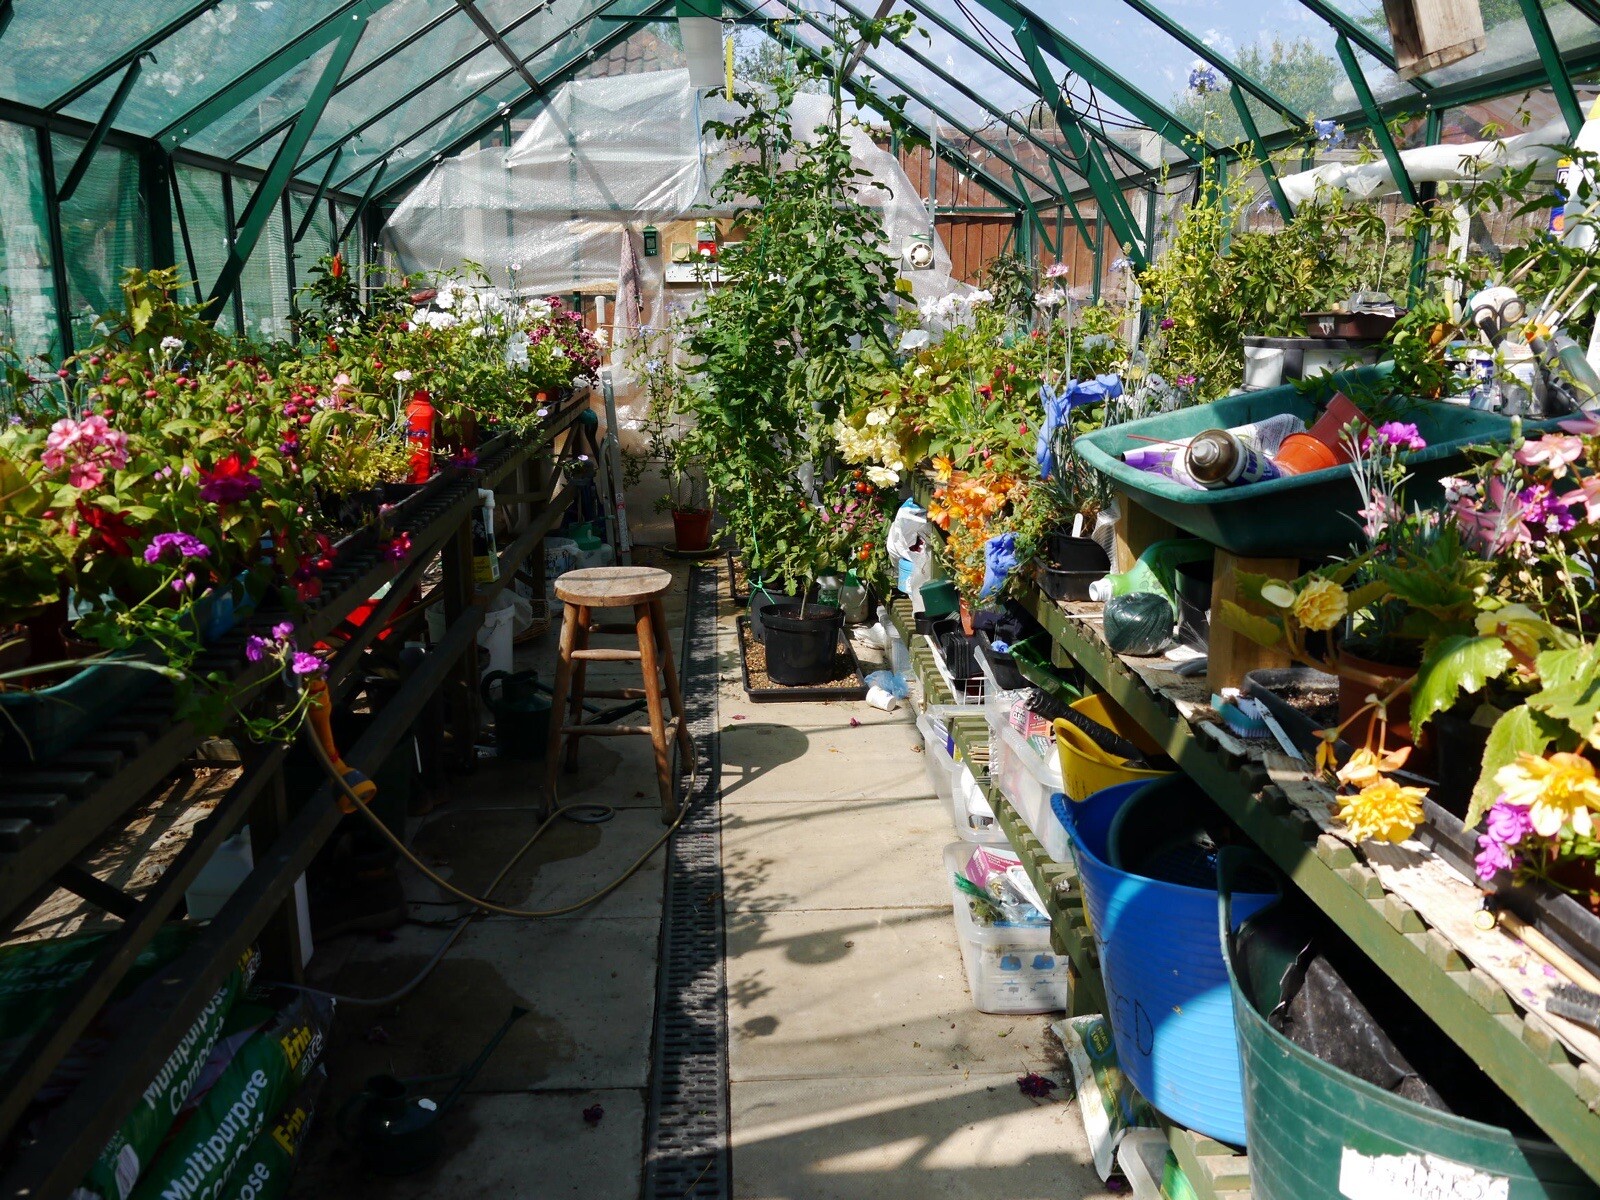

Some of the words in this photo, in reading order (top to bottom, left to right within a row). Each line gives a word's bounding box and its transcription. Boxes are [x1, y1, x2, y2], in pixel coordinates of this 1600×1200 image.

[280, 1024, 312, 1072] Erin
[160, 1069, 268, 1200] Multipurpose
[235, 1162, 270, 1200] ose
